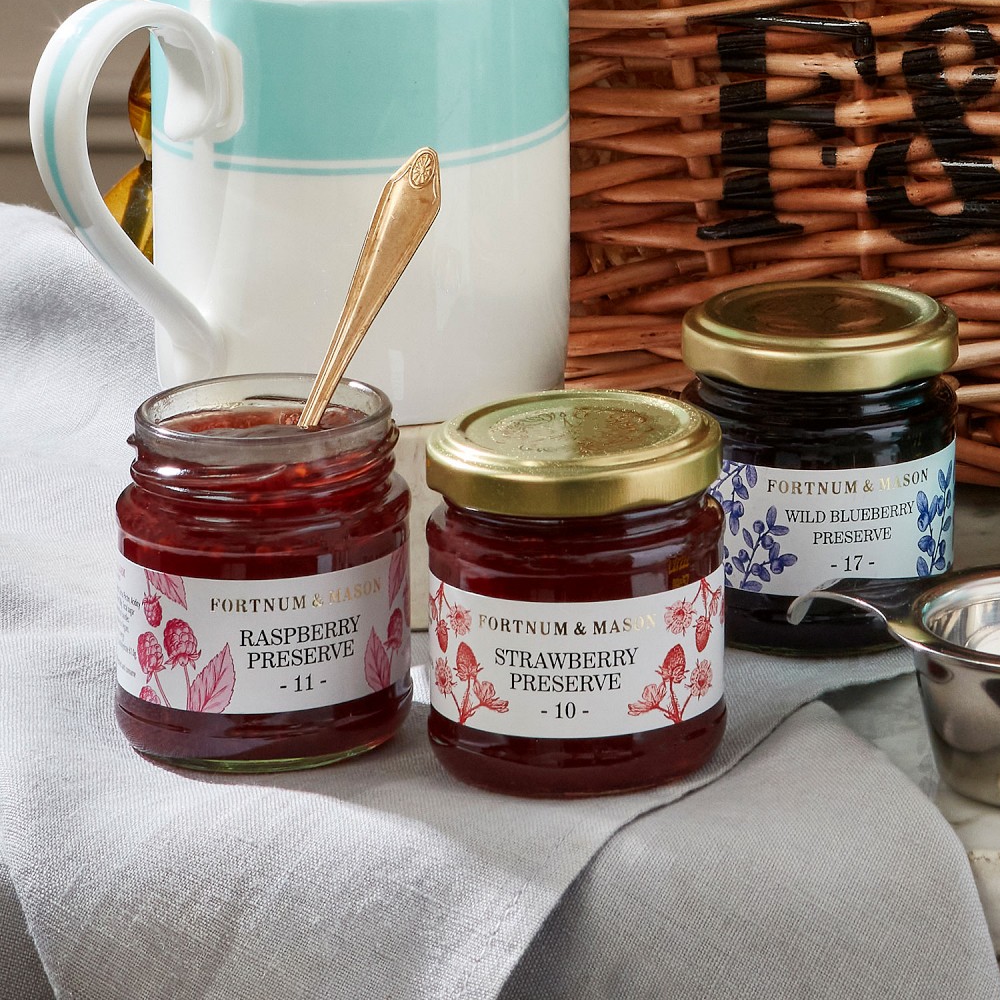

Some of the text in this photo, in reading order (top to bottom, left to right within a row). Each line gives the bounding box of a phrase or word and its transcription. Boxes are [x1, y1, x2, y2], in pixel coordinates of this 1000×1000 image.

[767, 467, 929, 496] FORTNUM & MASON
[785, 500, 916, 525] WILD BLUEBERRY
[812, 527, 892, 546] PRESERVE
[210, 577, 382, 614] FORTNUM & MASON
[239, 613, 361, 648] RASPBERRY
[478, 613, 657, 637] FORTNUM & MASON
[247, 638, 355, 670] PRESERVE
[494, 647, 639, 670] STRAWBERRY
[509, 672, 622, 693] PRESERVE
